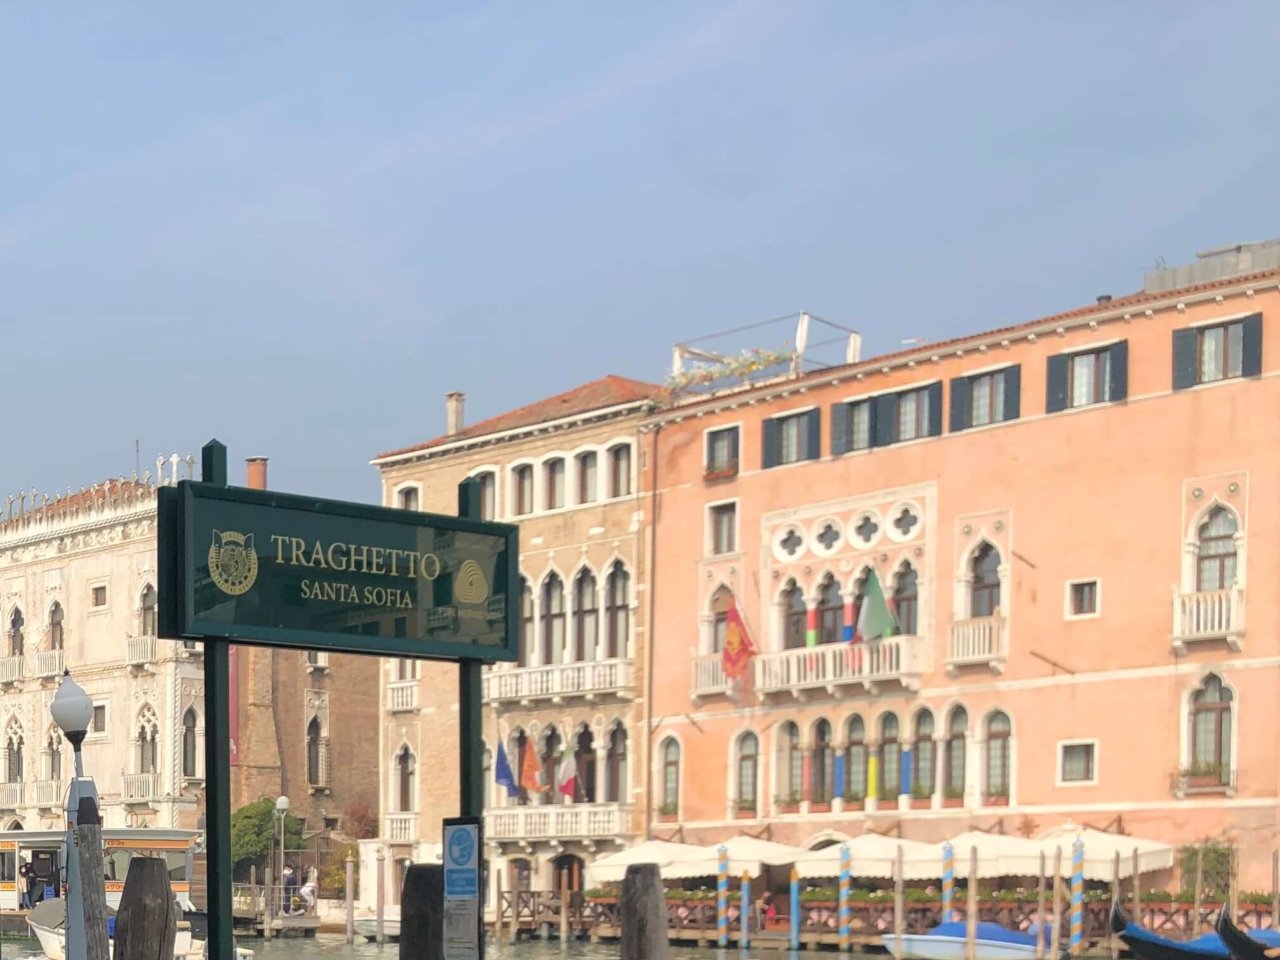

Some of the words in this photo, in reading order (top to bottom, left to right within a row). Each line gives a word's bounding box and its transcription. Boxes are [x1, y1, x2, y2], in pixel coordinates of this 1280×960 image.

[271, 535, 440, 580] TRAGHETTO
[301, 579, 359, 603] SANTA
[364, 585, 413, 608] SOFIA
